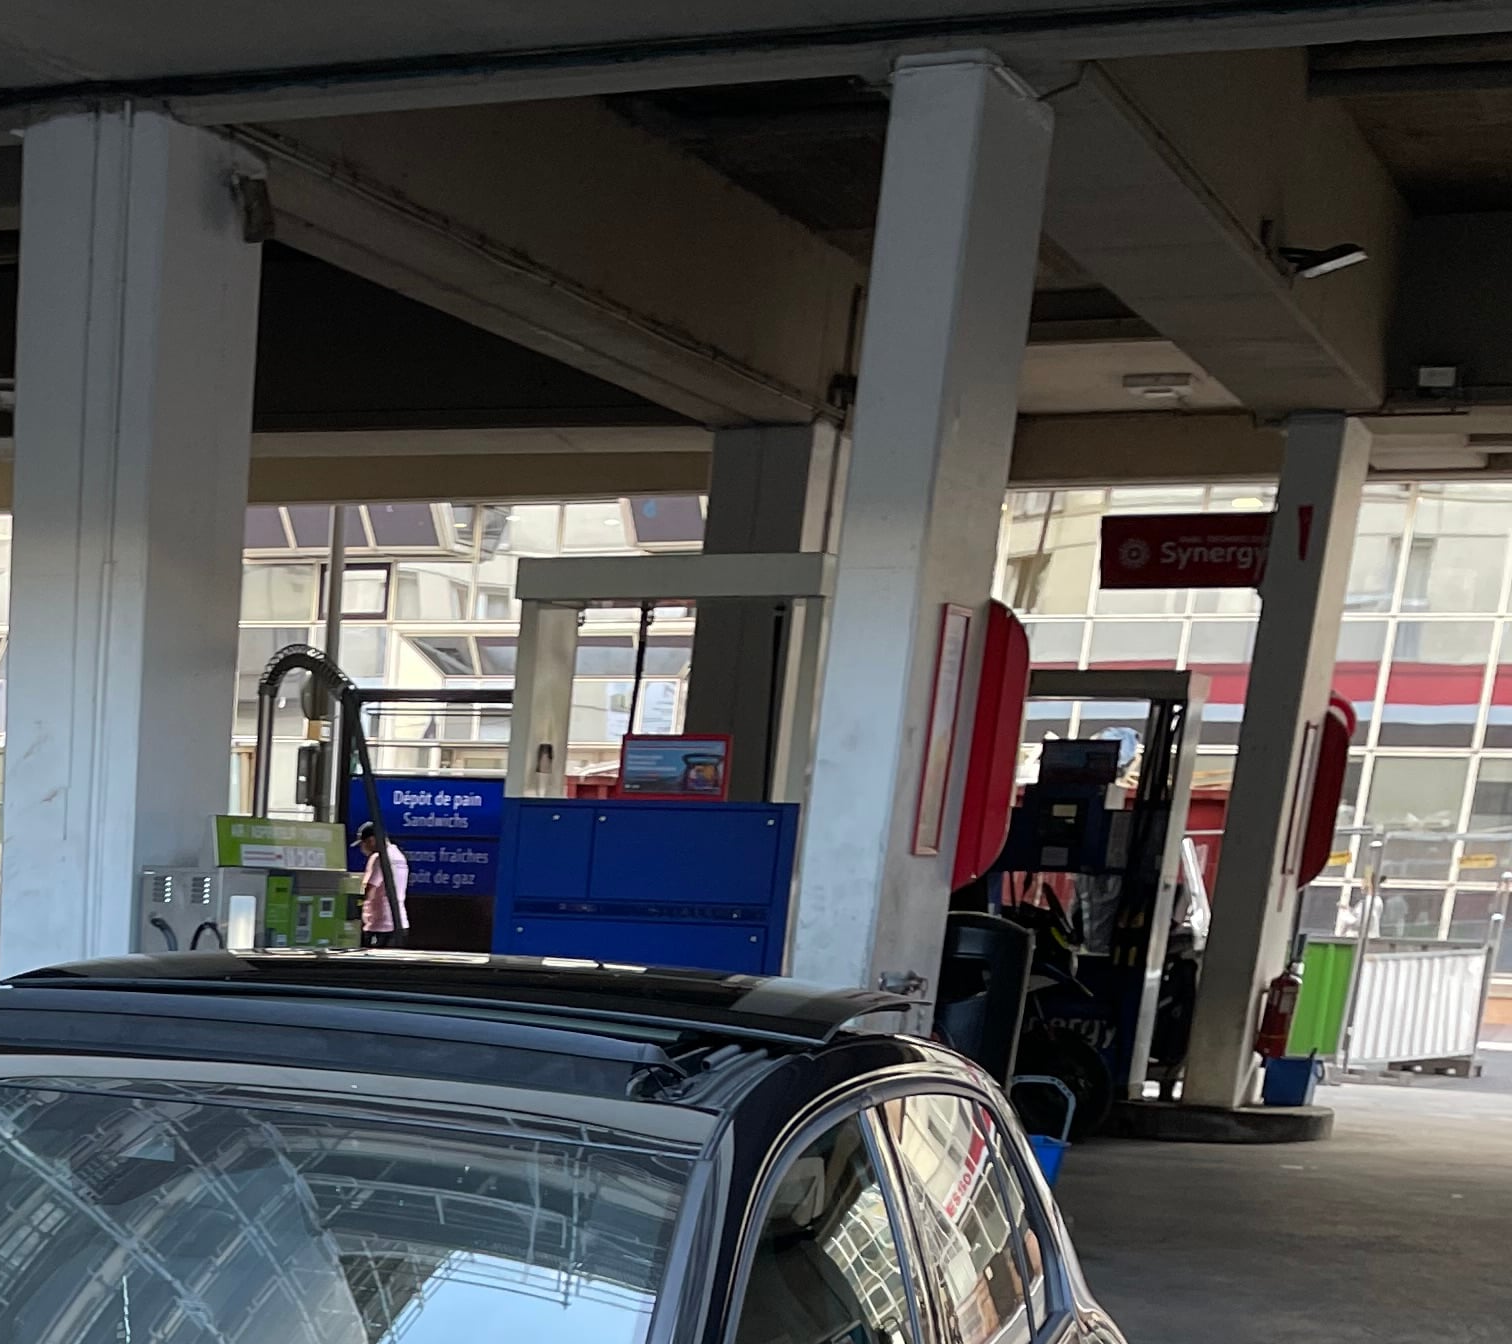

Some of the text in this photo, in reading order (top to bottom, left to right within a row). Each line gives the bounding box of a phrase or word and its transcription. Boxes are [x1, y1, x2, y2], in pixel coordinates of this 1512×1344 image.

[393, 790, 482, 810] Dépôt de pain
[403, 812, 469, 829] Sandwichs
[433, 869, 449, 885] de
[452, 872, 476, 888] gaz
